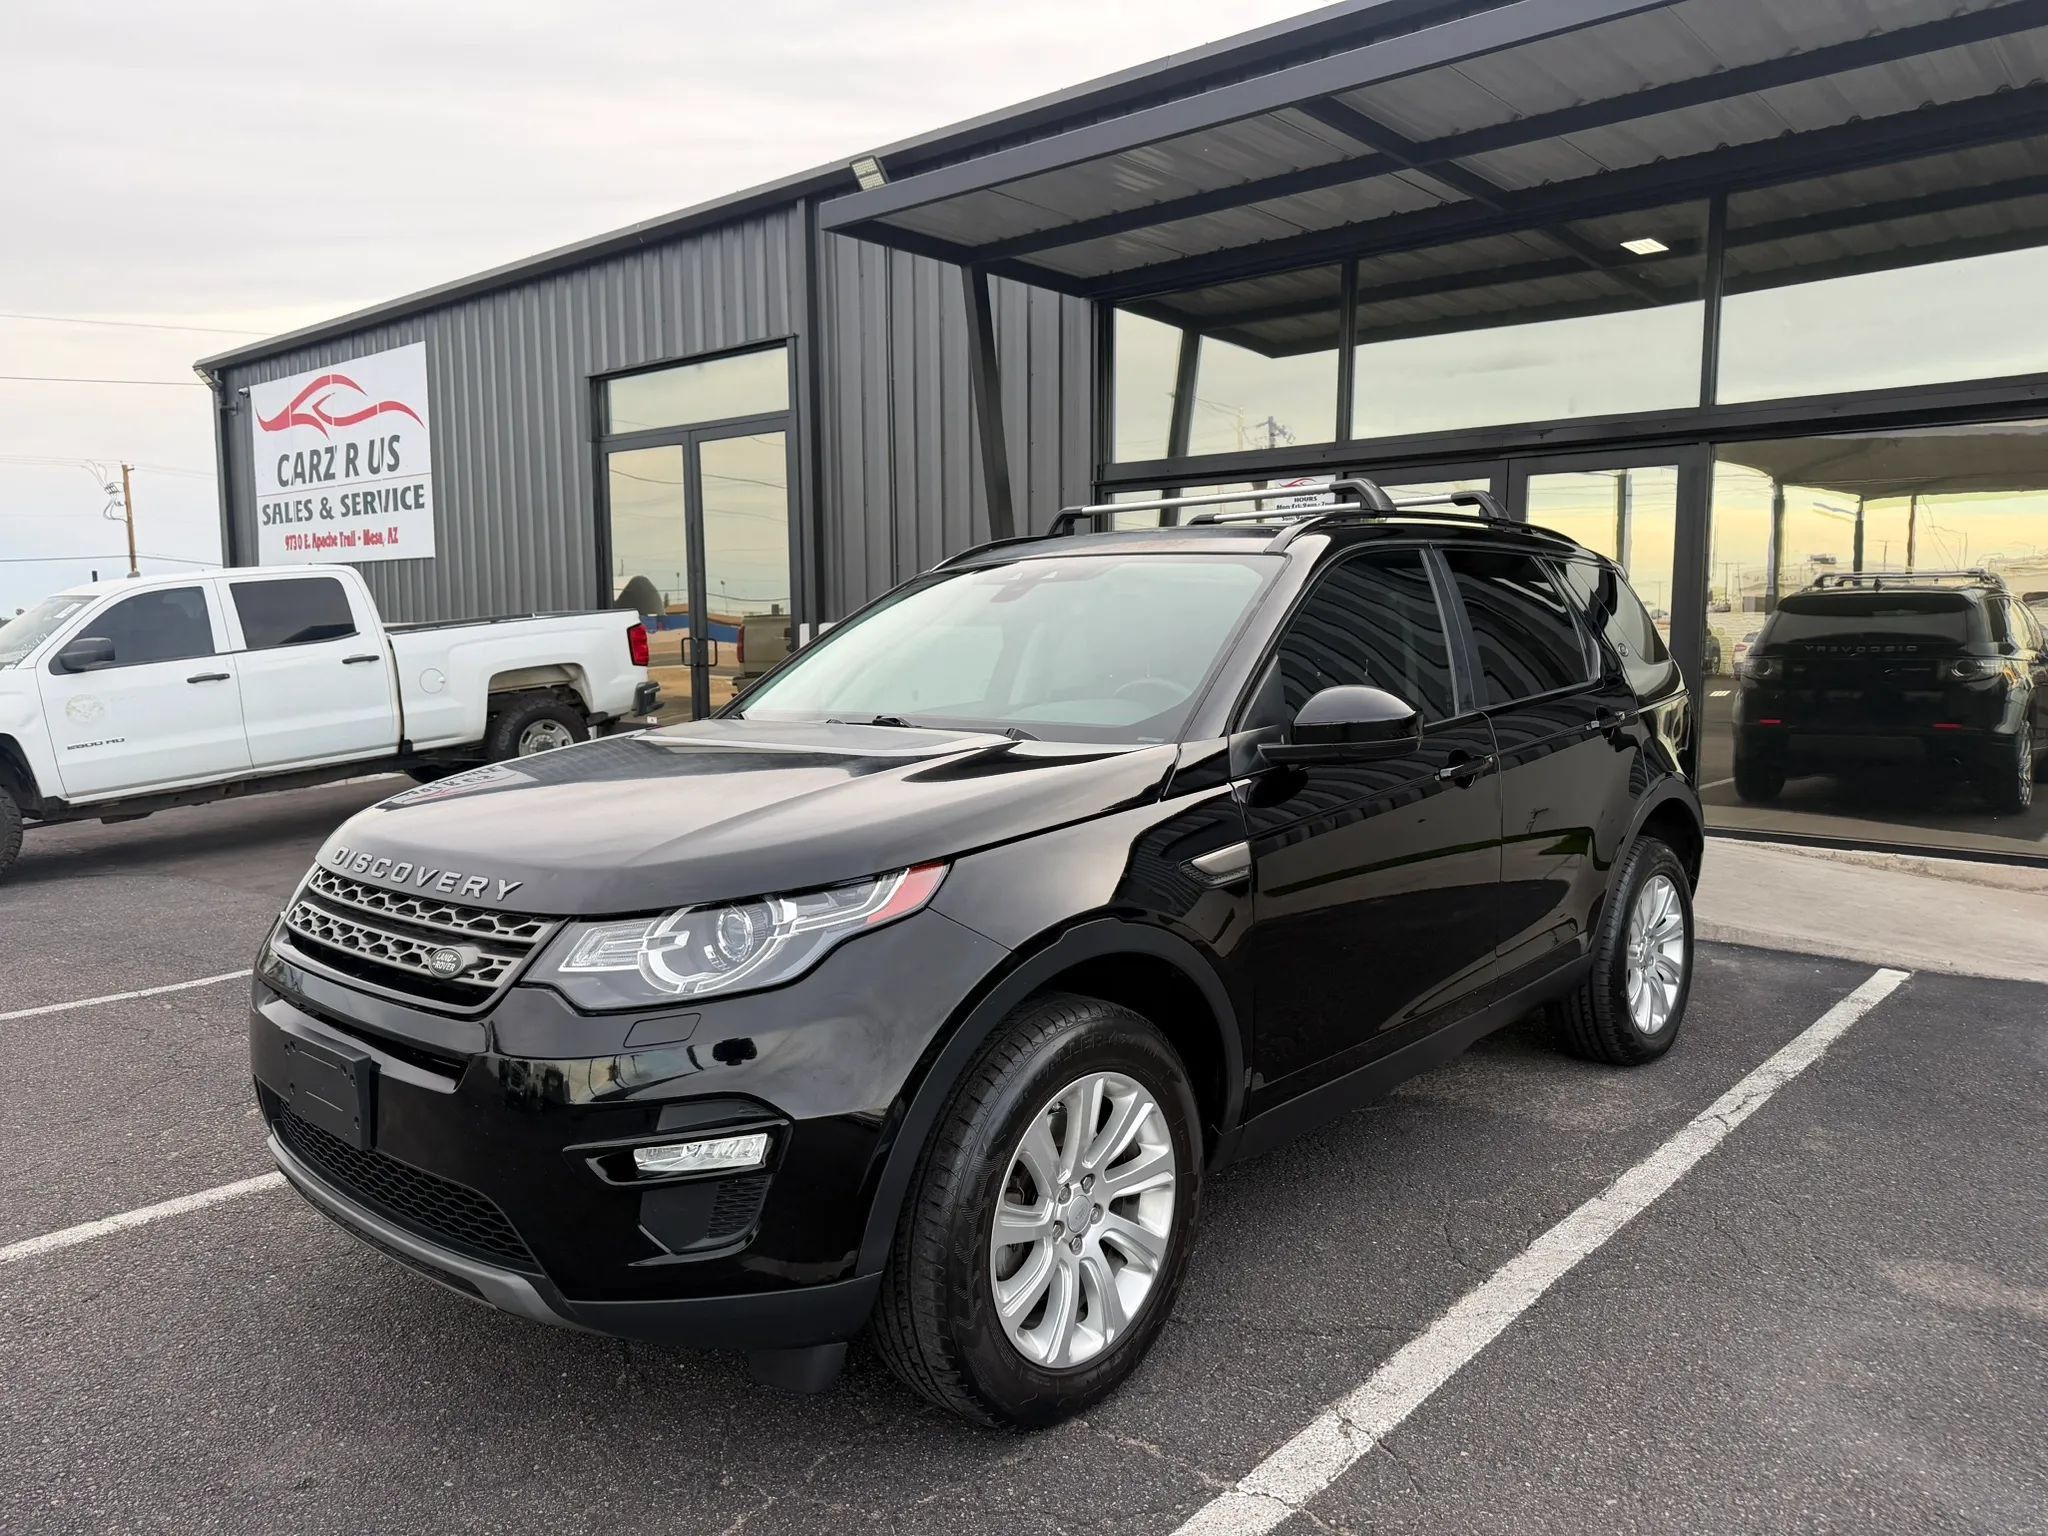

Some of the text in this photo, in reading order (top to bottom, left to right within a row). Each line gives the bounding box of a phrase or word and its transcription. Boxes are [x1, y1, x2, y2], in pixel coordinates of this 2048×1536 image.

[344, 442, 360, 478] R
[367, 434, 401, 475] US
[262, 484, 425, 526] SALES & SERVICE
[284, 533, 303, 551] 9730
[311, 531, 338, 552] Apache
[338, 529, 356, 548] Trail
[387, 526, 399, 544] AZ
[331, 846, 524, 901] DISCOVERY
